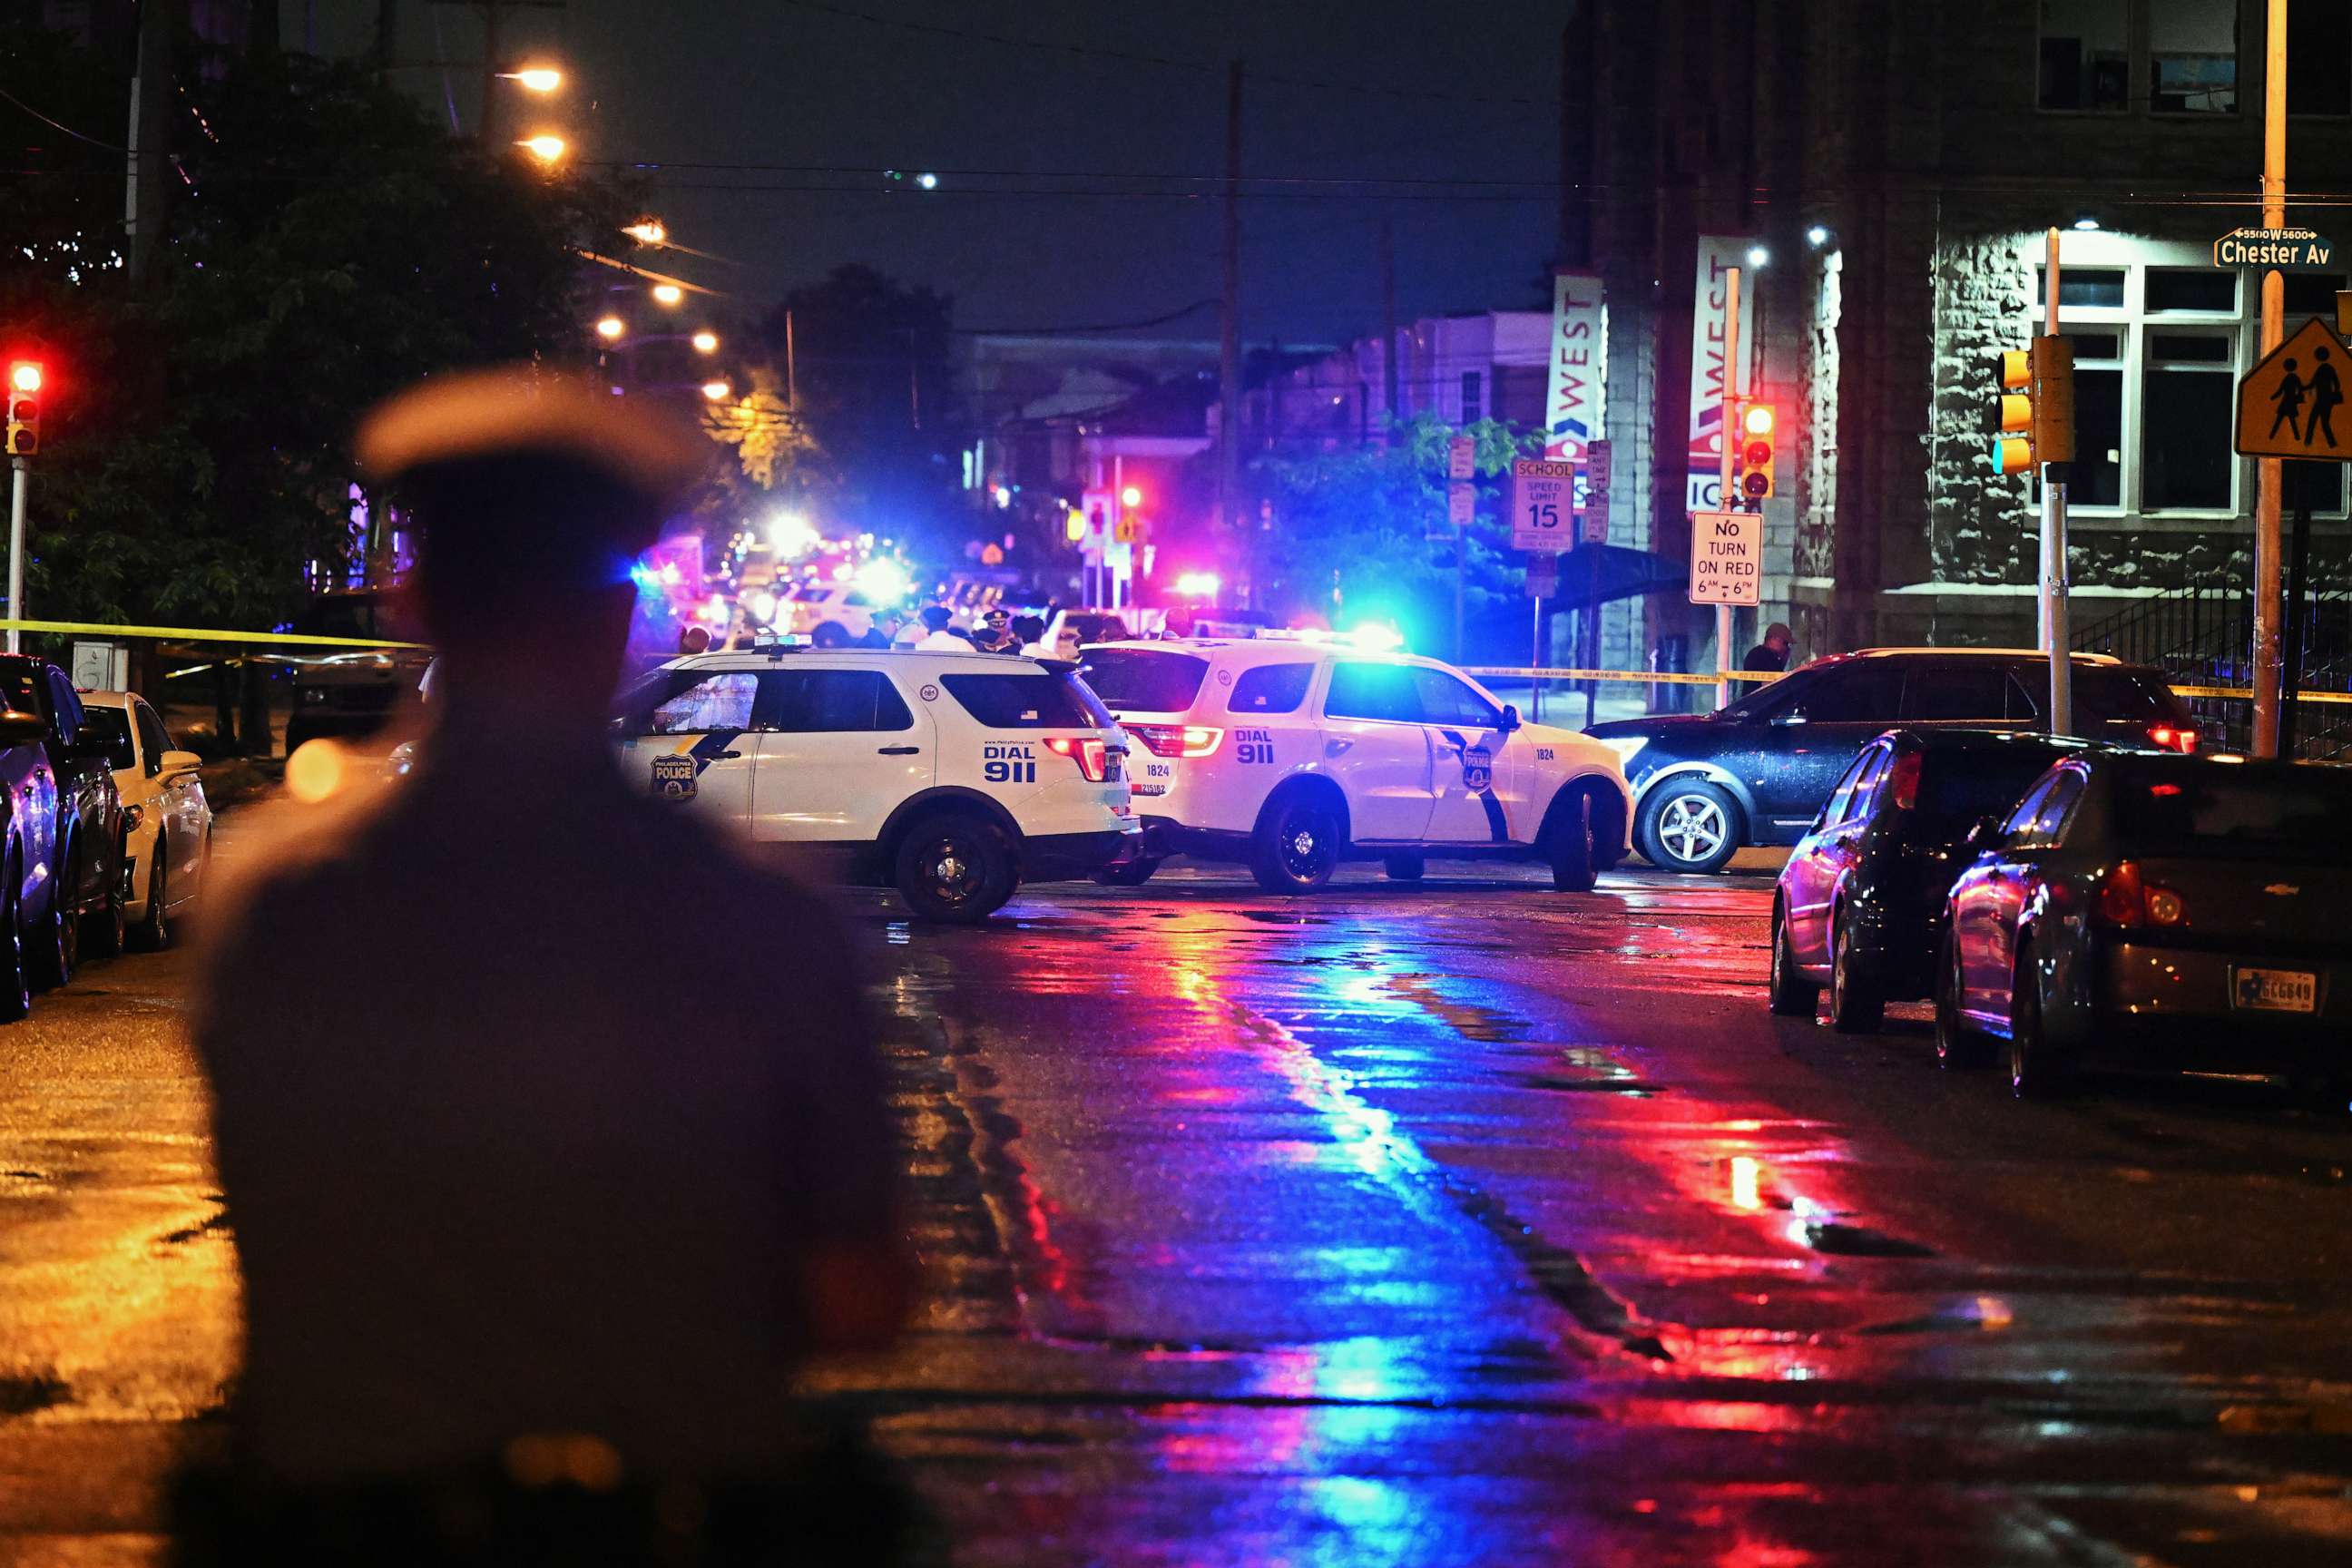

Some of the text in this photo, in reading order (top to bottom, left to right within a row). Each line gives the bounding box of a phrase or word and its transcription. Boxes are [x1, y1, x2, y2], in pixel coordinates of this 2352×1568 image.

[2269, 229, 2282, 240] W
[2282, 230, 2308, 240] 5600
[2221, 240, 2329, 264] Chester Av
[1559, 291, 1591, 410] WEST
[1519, 464, 1571, 476] SCHOOL
[1527, 482, 1561, 492] SPEED
[1530, 493, 1557, 501] LIMIT
[1529, 505, 1558, 528] 15
[1715, 522, 1740, 536] NO
[1709, 542, 1746, 555] TURN
[1698, 560, 1754, 575] ON RED
[1235, 730, 1272, 742] DIAL
[985, 747, 1035, 759] DIAL
[1237, 744, 1274, 764] 911
[1536, 749, 1553, 760] 1824
[656, 767, 691, 779] POLICE
[985, 761, 1035, 782] 911
[1147, 765, 1170, 777] 1824
